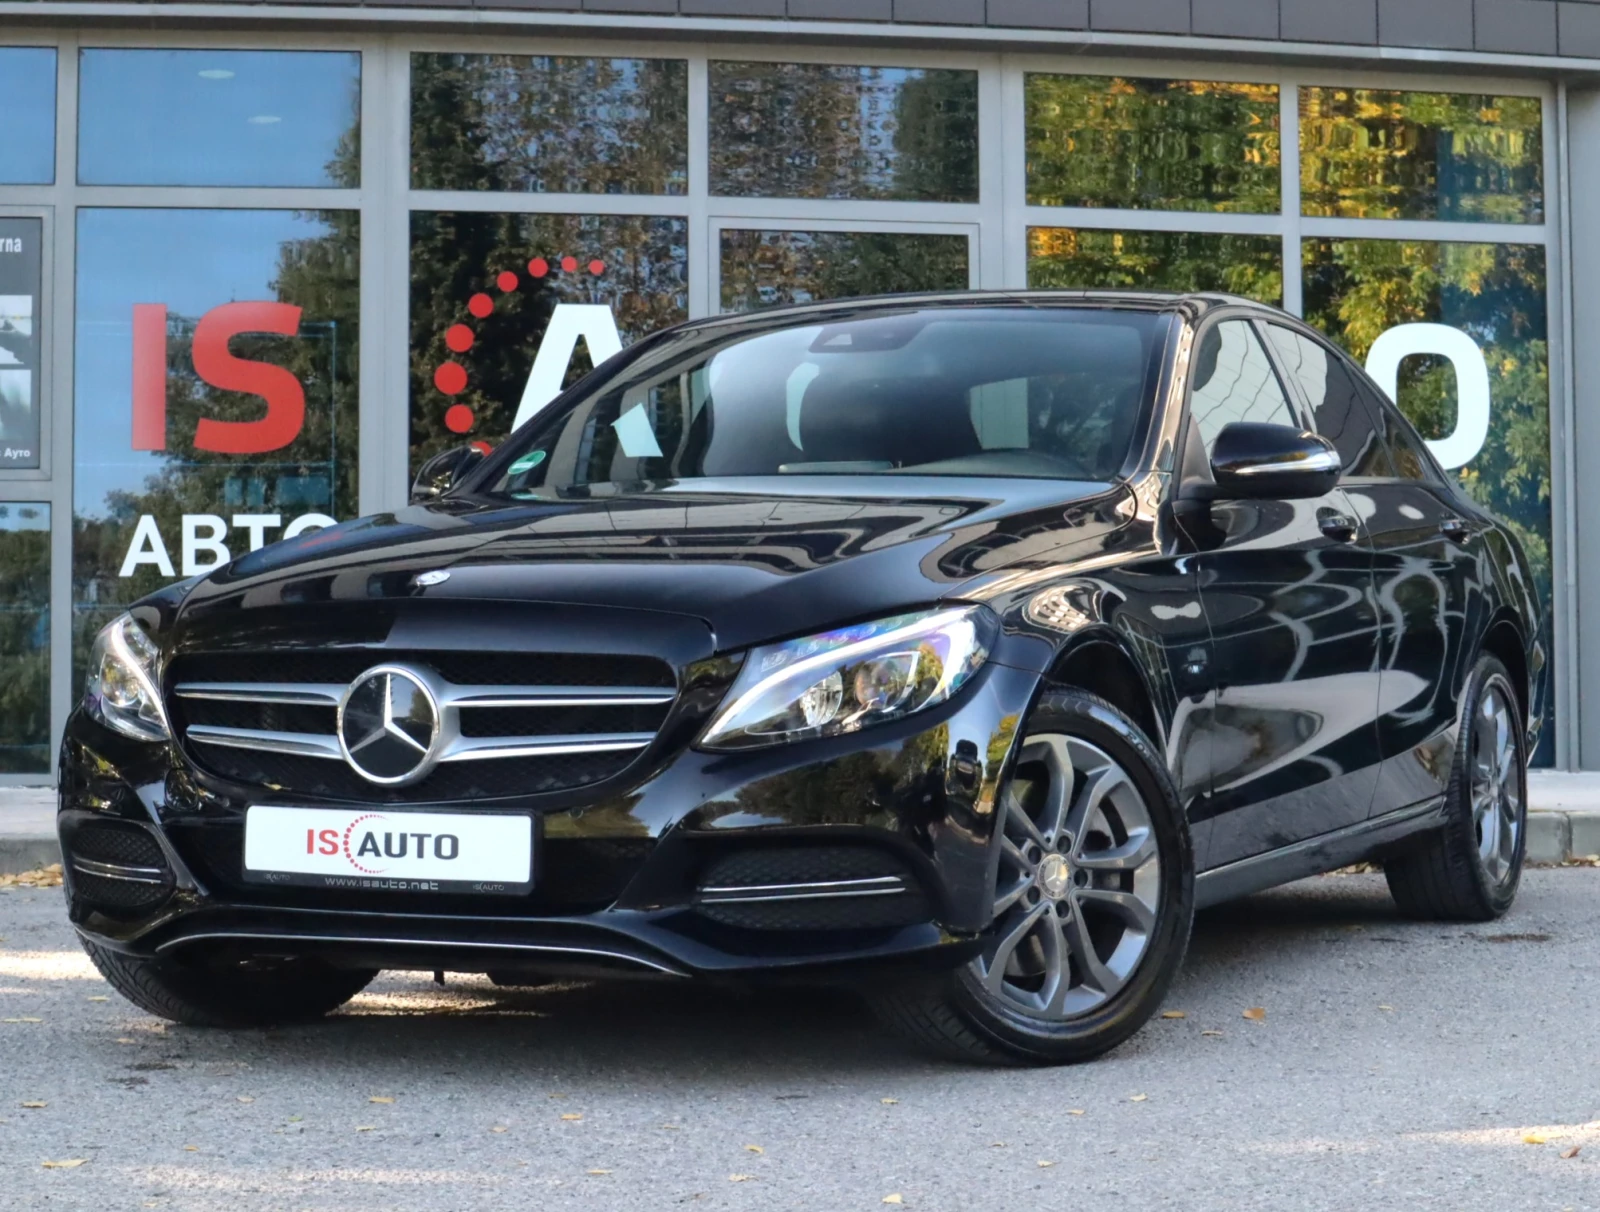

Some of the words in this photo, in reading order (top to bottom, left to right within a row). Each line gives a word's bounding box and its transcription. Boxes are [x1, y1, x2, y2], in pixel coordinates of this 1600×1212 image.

[131, 300, 306, 454] IS
[306, 828, 339, 856] IS
[357, 831, 459, 860] AUTO
[325, 877, 439, 891] www.isauto.net
